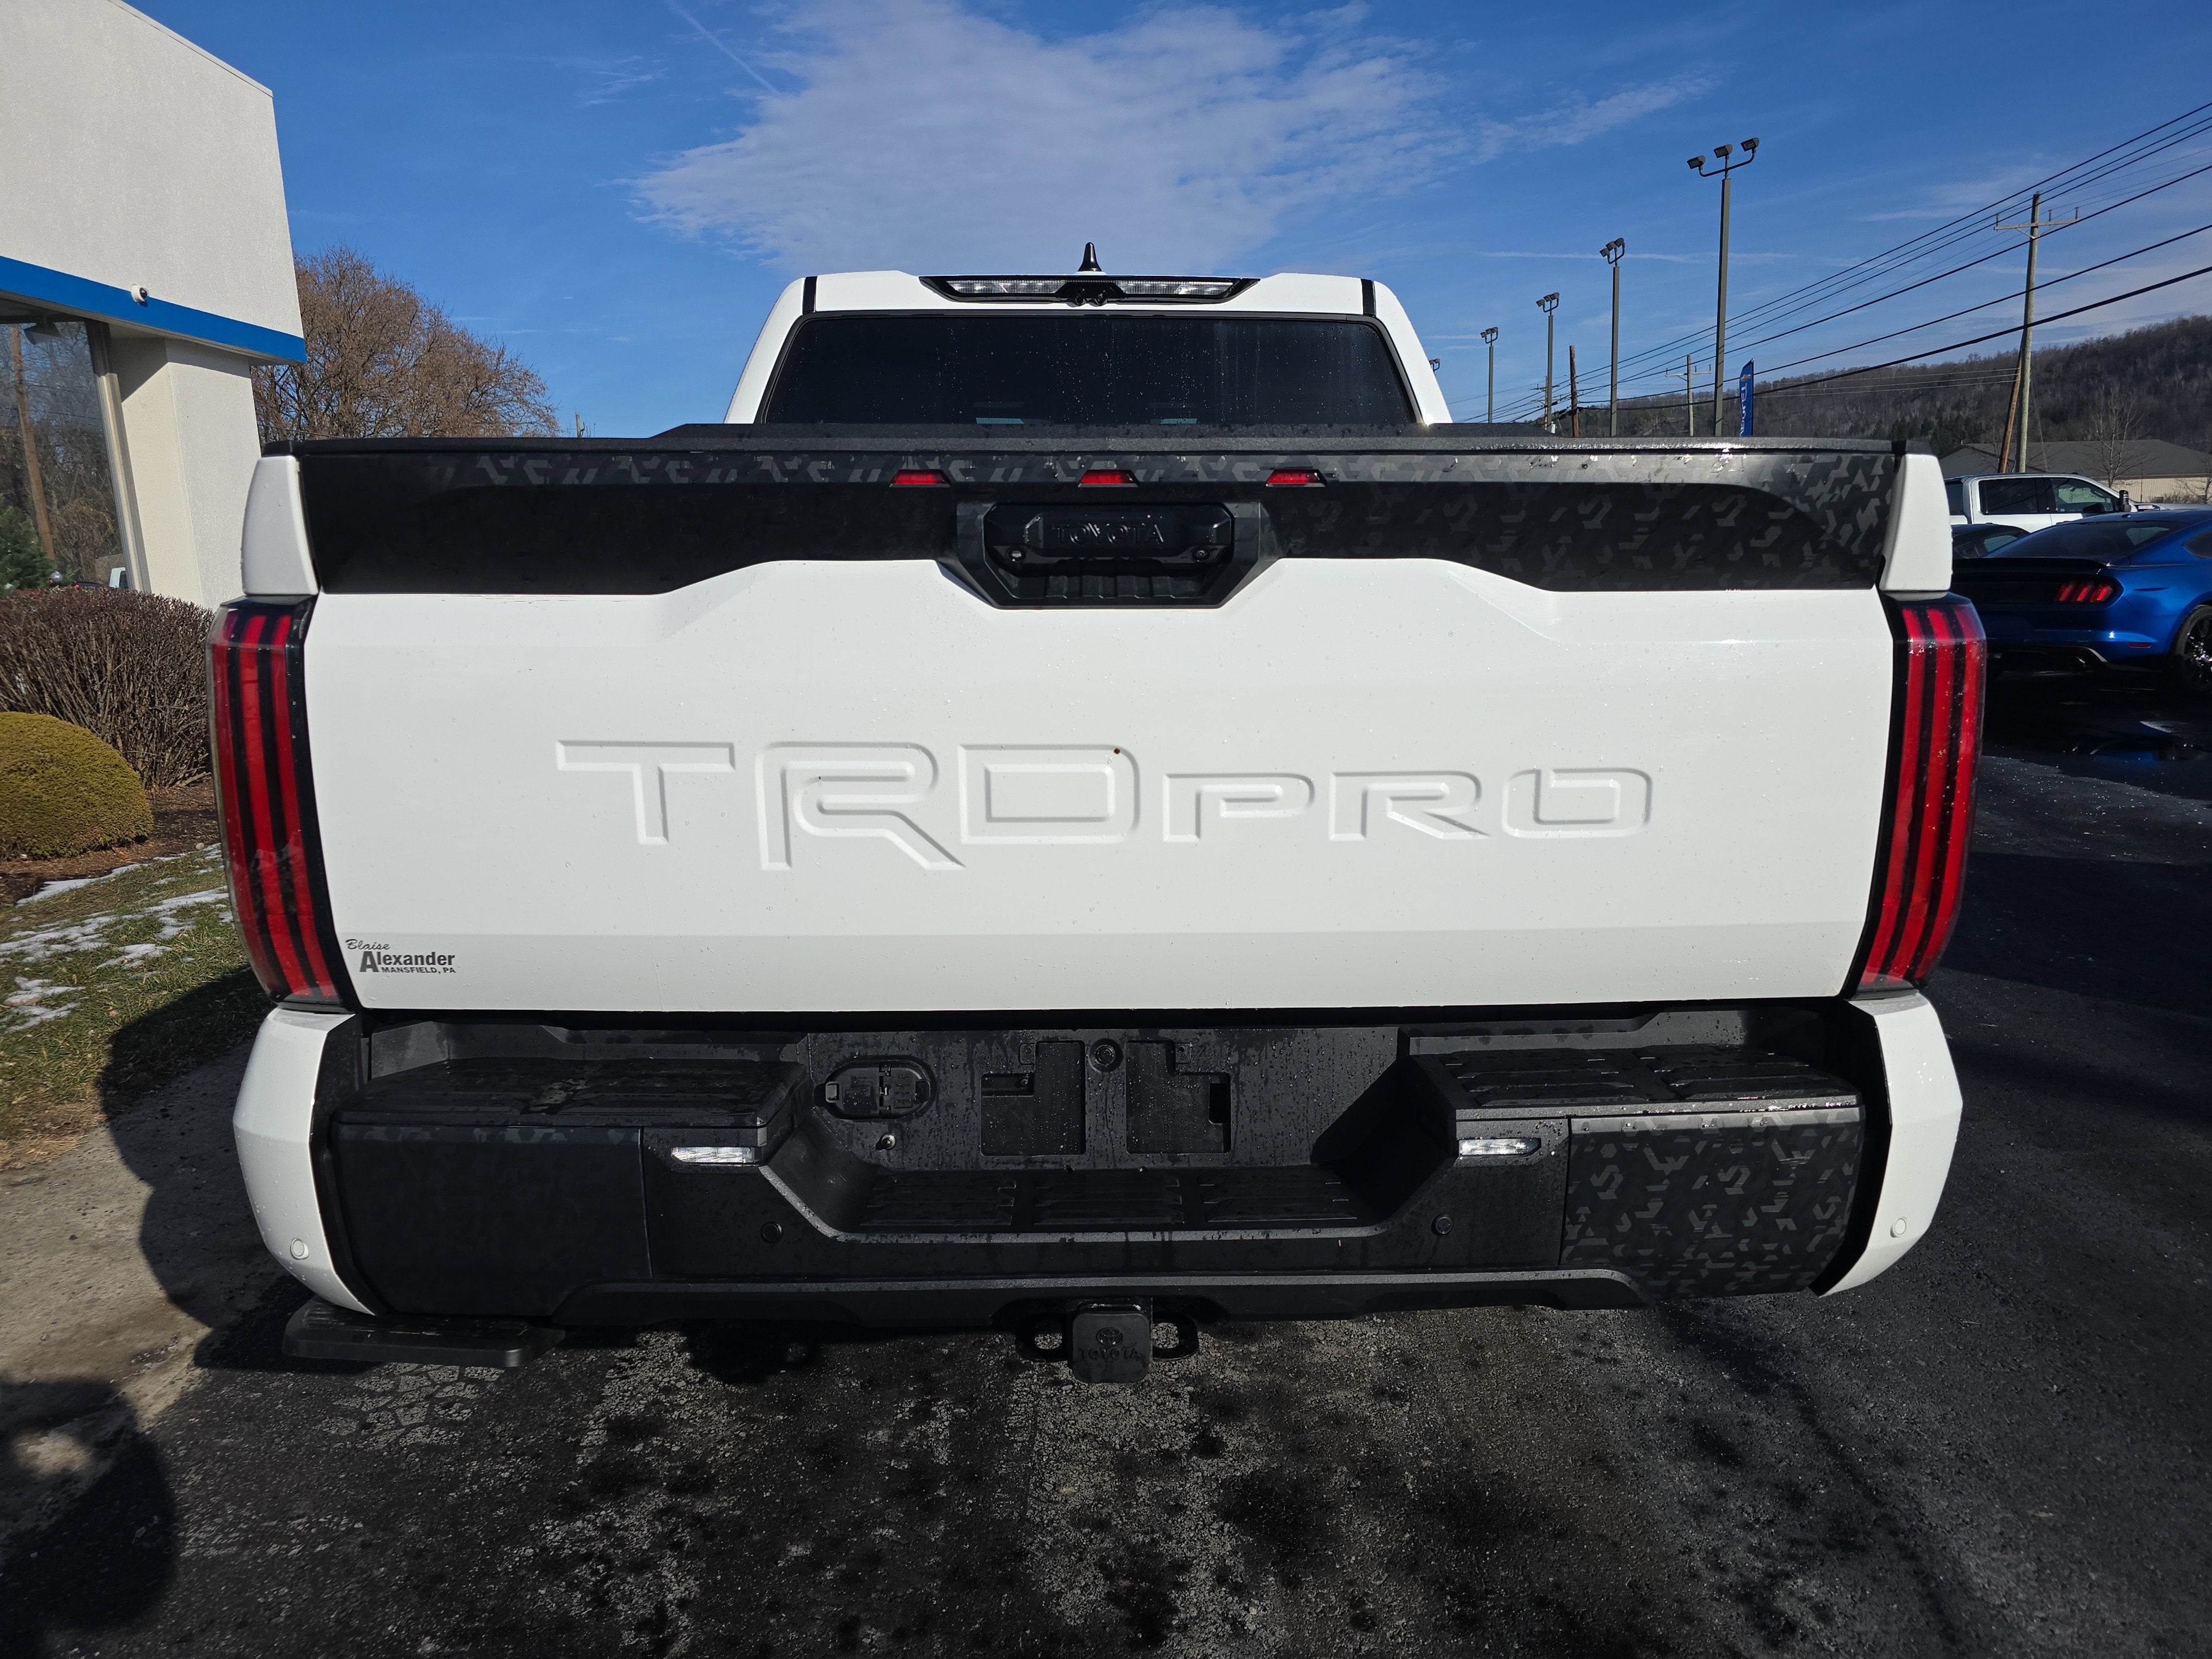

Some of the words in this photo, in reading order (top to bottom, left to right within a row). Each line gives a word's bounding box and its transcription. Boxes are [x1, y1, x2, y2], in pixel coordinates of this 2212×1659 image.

[1052, 523, 1165, 545] TOYOTA
[556, 740, 1140, 871] TRD
[1162, 768, 1651, 841] PRO
[345, 938, 390, 950] Blaise
[359, 951, 455, 973] Alexander
[1078, 1348, 1141, 1360] TOYOTA
